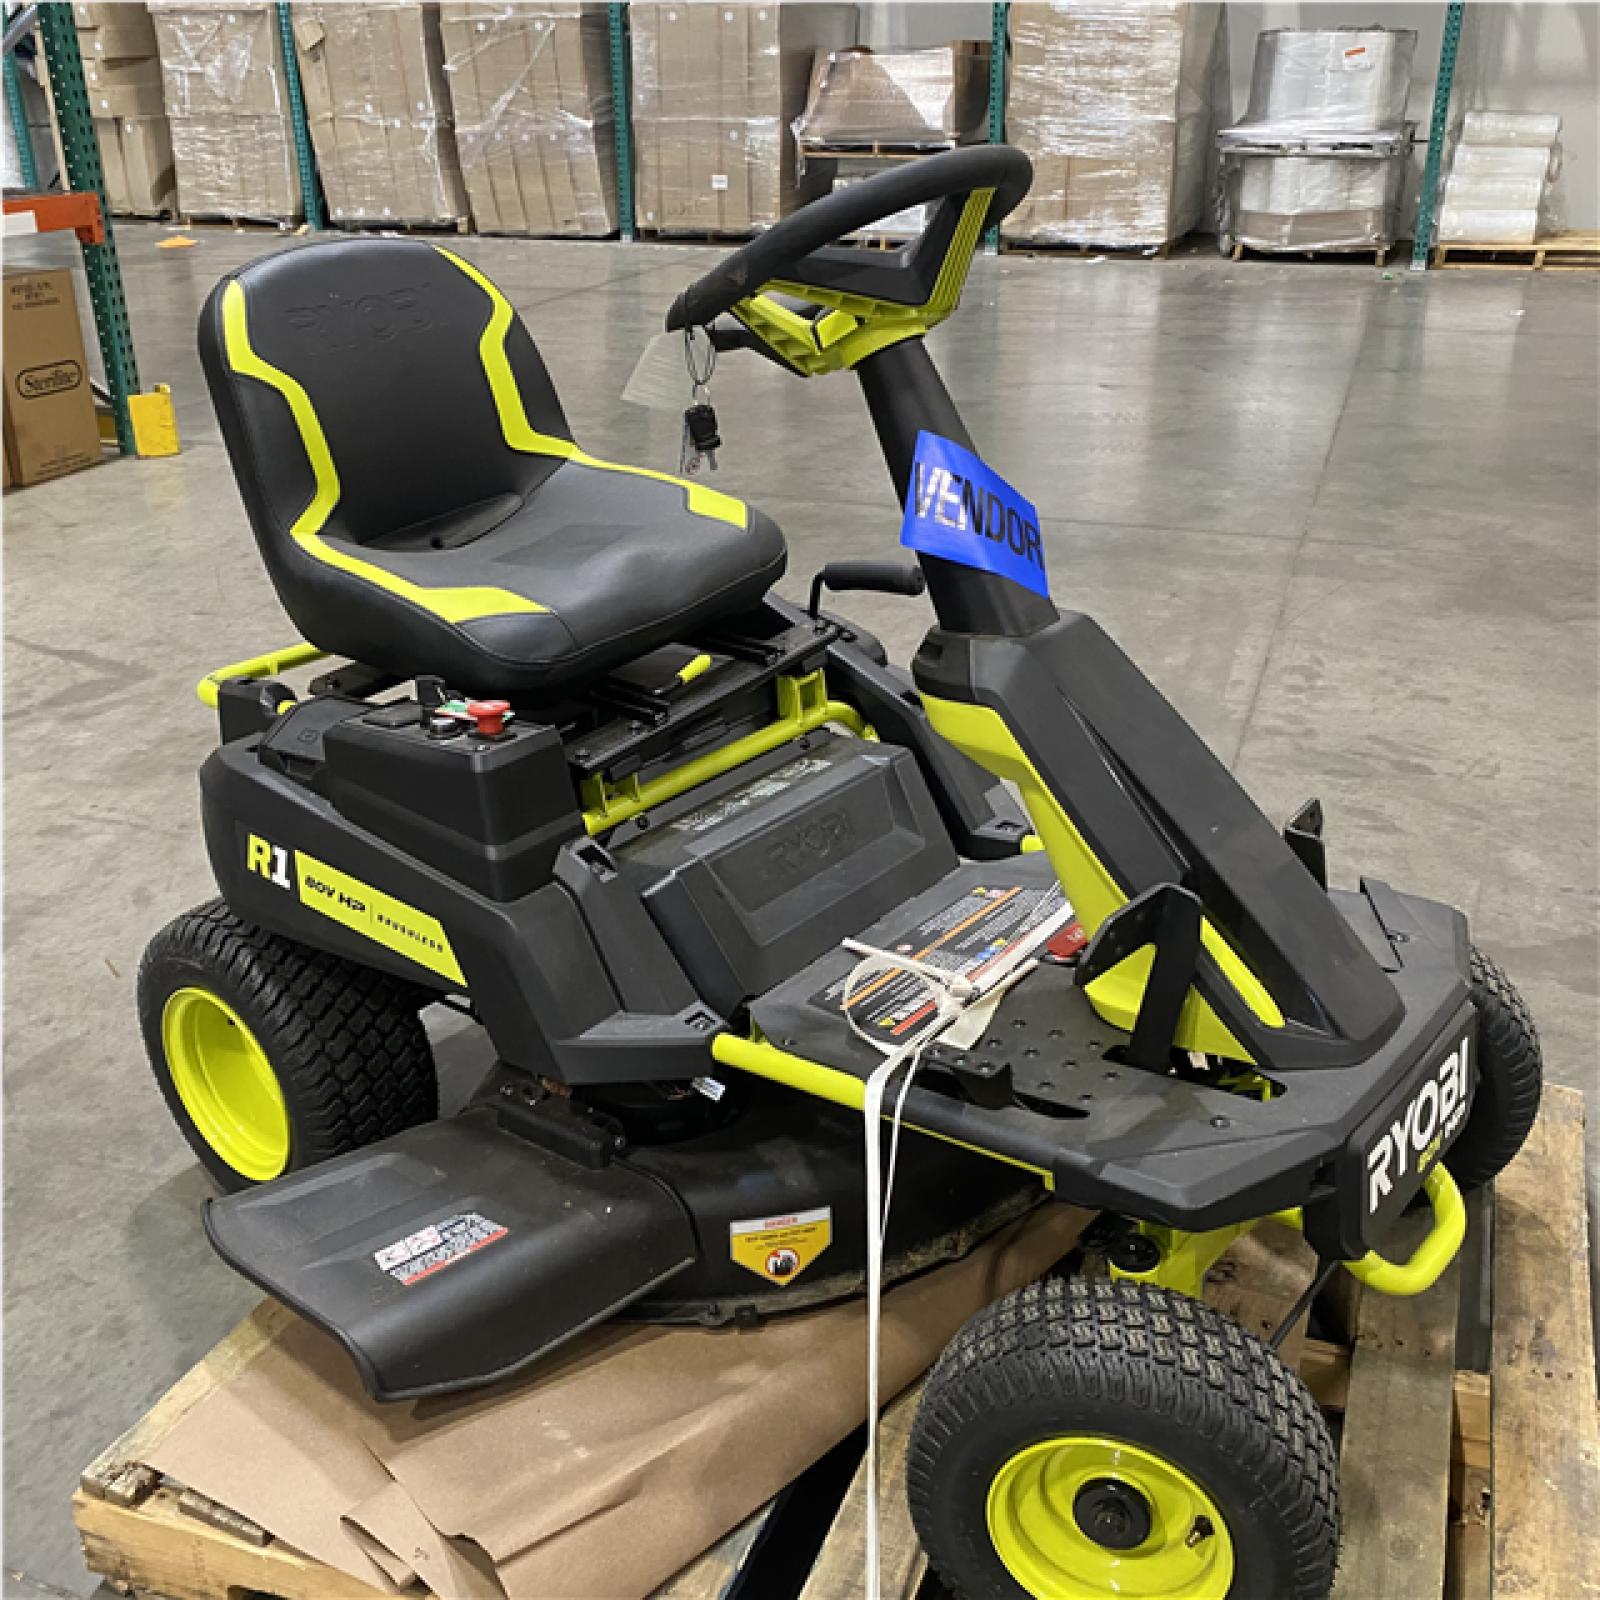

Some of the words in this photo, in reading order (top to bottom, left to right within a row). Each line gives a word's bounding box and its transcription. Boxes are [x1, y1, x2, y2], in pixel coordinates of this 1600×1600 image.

[914, 462, 1045, 571] VENDOR
[247, 832, 291, 891] R1
[1367, 1036, 1469, 1215] RYOBI
